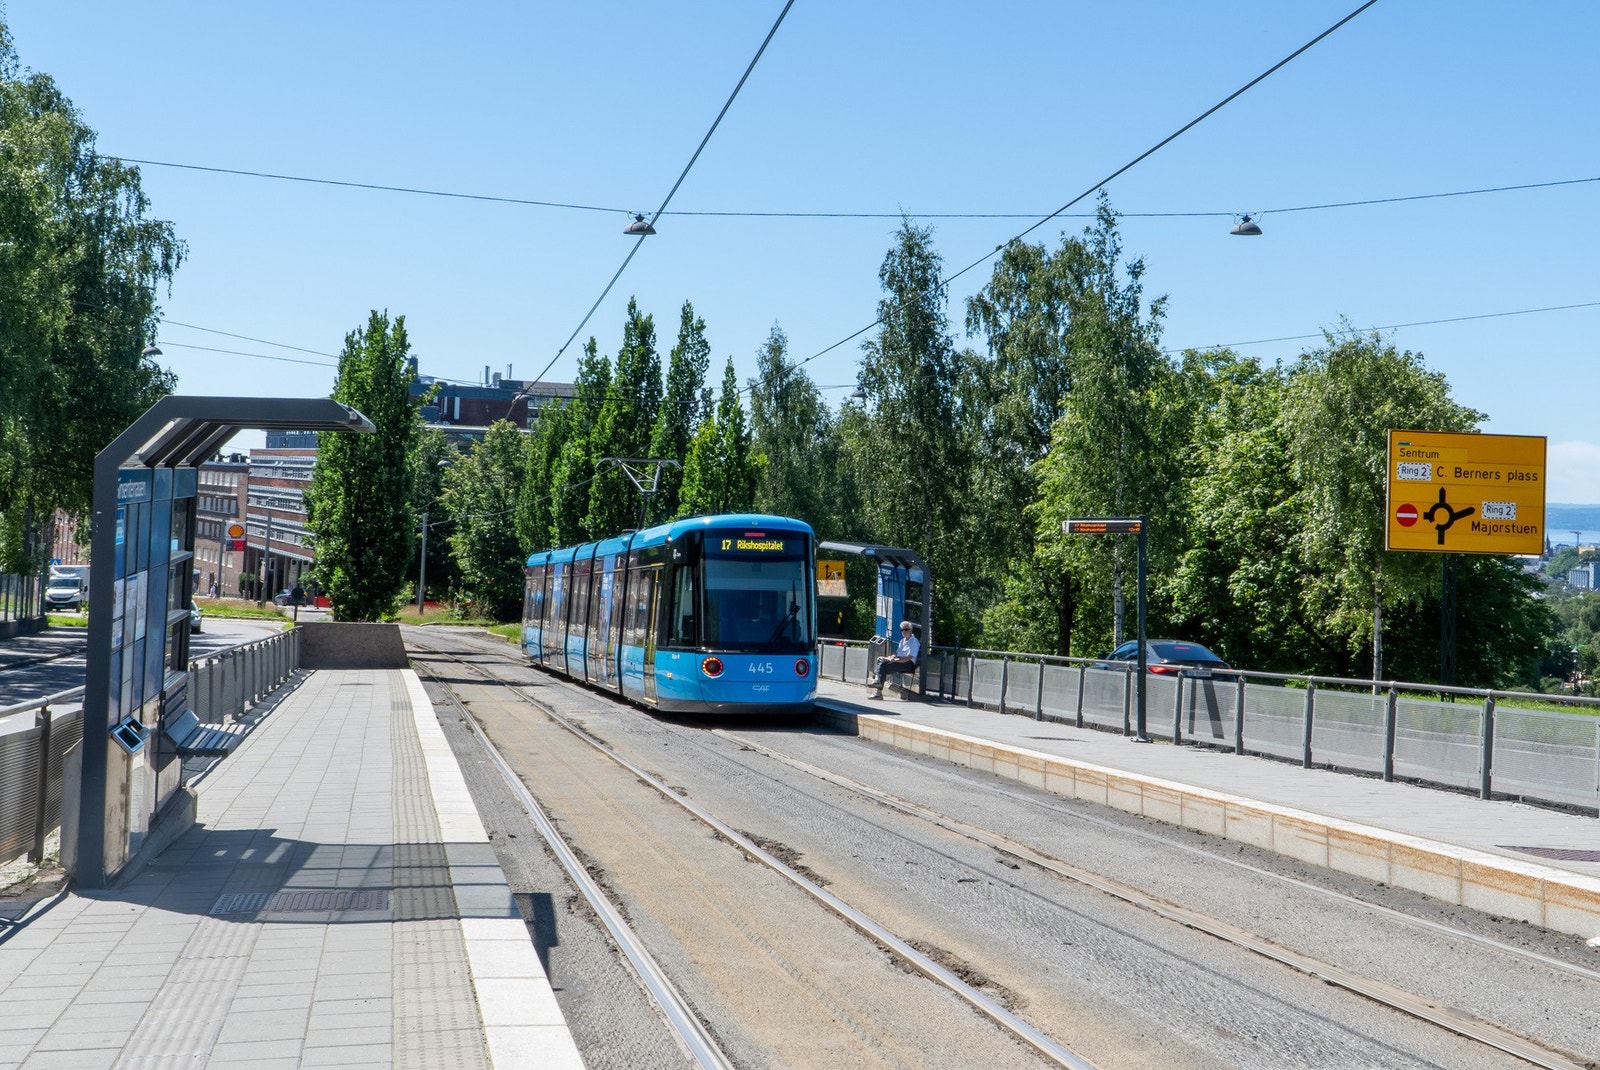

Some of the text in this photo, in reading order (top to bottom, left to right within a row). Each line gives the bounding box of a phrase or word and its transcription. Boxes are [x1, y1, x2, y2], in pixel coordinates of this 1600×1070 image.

[1399, 447, 1440, 459] Sentrum
[1401, 466, 1428, 477] Ring 2
[1436, 466, 1539, 483] C. Berners plass
[1485, 505, 1512, 516] Ring 2
[1471, 520, 1538, 536] Majorstuen
[721, 539, 784, 552] 17 Rikshospitalet
[748, 662, 774, 674] 445
